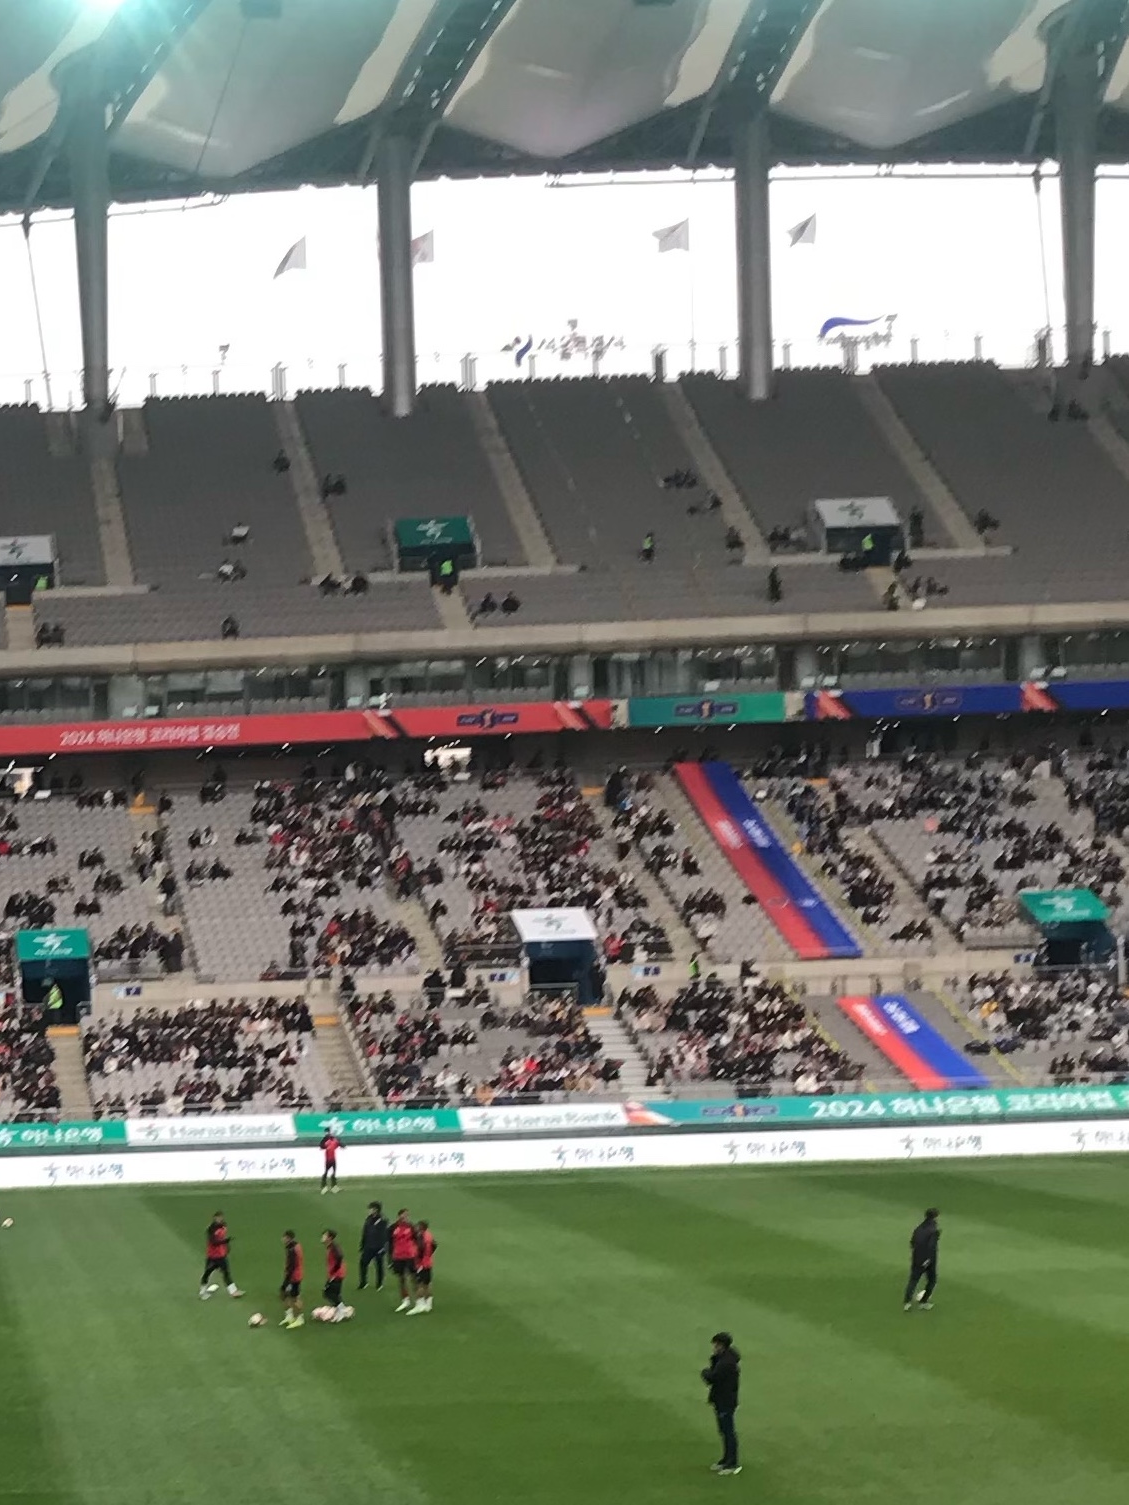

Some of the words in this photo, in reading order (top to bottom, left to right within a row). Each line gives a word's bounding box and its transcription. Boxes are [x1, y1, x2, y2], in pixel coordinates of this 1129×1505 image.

[60, 730, 96, 747] 2024
[809, 1099, 887, 1119] 2024
[888, 1094, 1002, 1116] 하나은행
